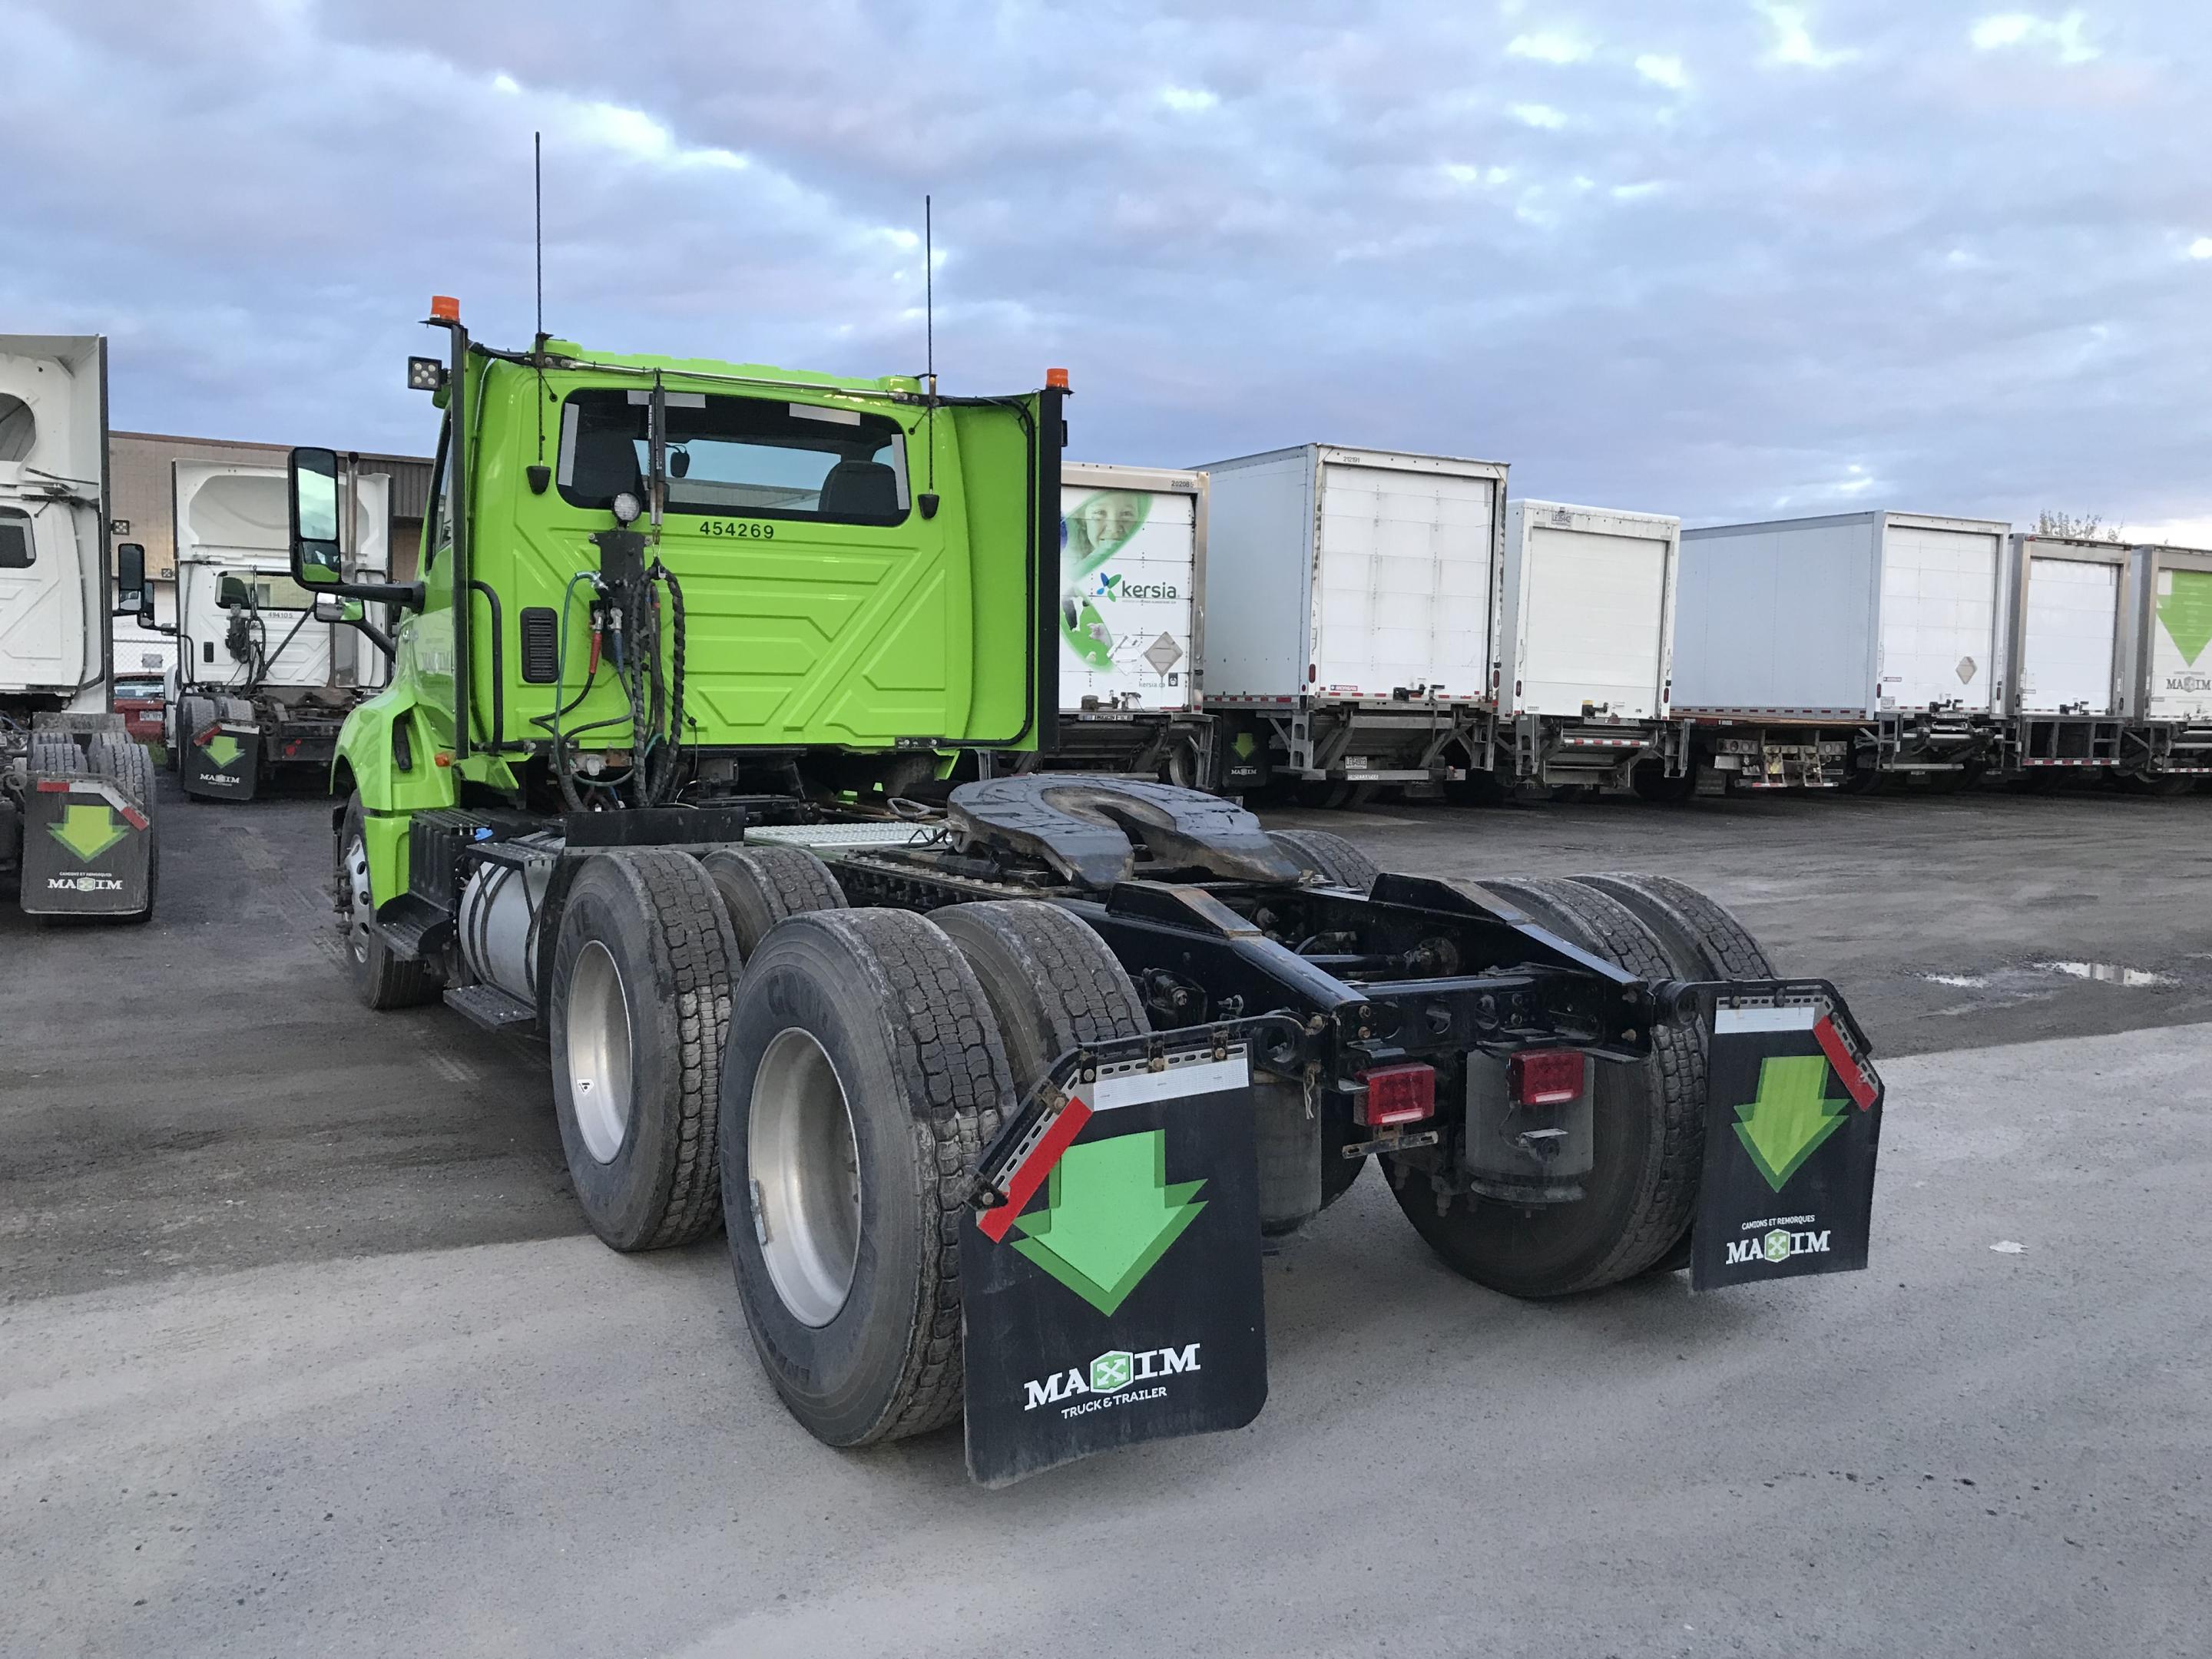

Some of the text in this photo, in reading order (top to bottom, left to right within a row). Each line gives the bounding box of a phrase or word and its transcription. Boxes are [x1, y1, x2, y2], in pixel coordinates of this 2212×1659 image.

[700, 521, 774, 539] 454269
[1122, 580, 1177, 598] kersia
[48, 876, 123, 891] MAXIM
[1741, 1215, 1815, 1230] CAMIONS ET REMORQUES
[1726, 1229, 1831, 1264] MAXIM
[1024, 1343, 1201, 1411] MAXIM
[1061, 1399, 1101, 1419] TRUCK
[1113, 1386, 1167, 1406] TRAILER
